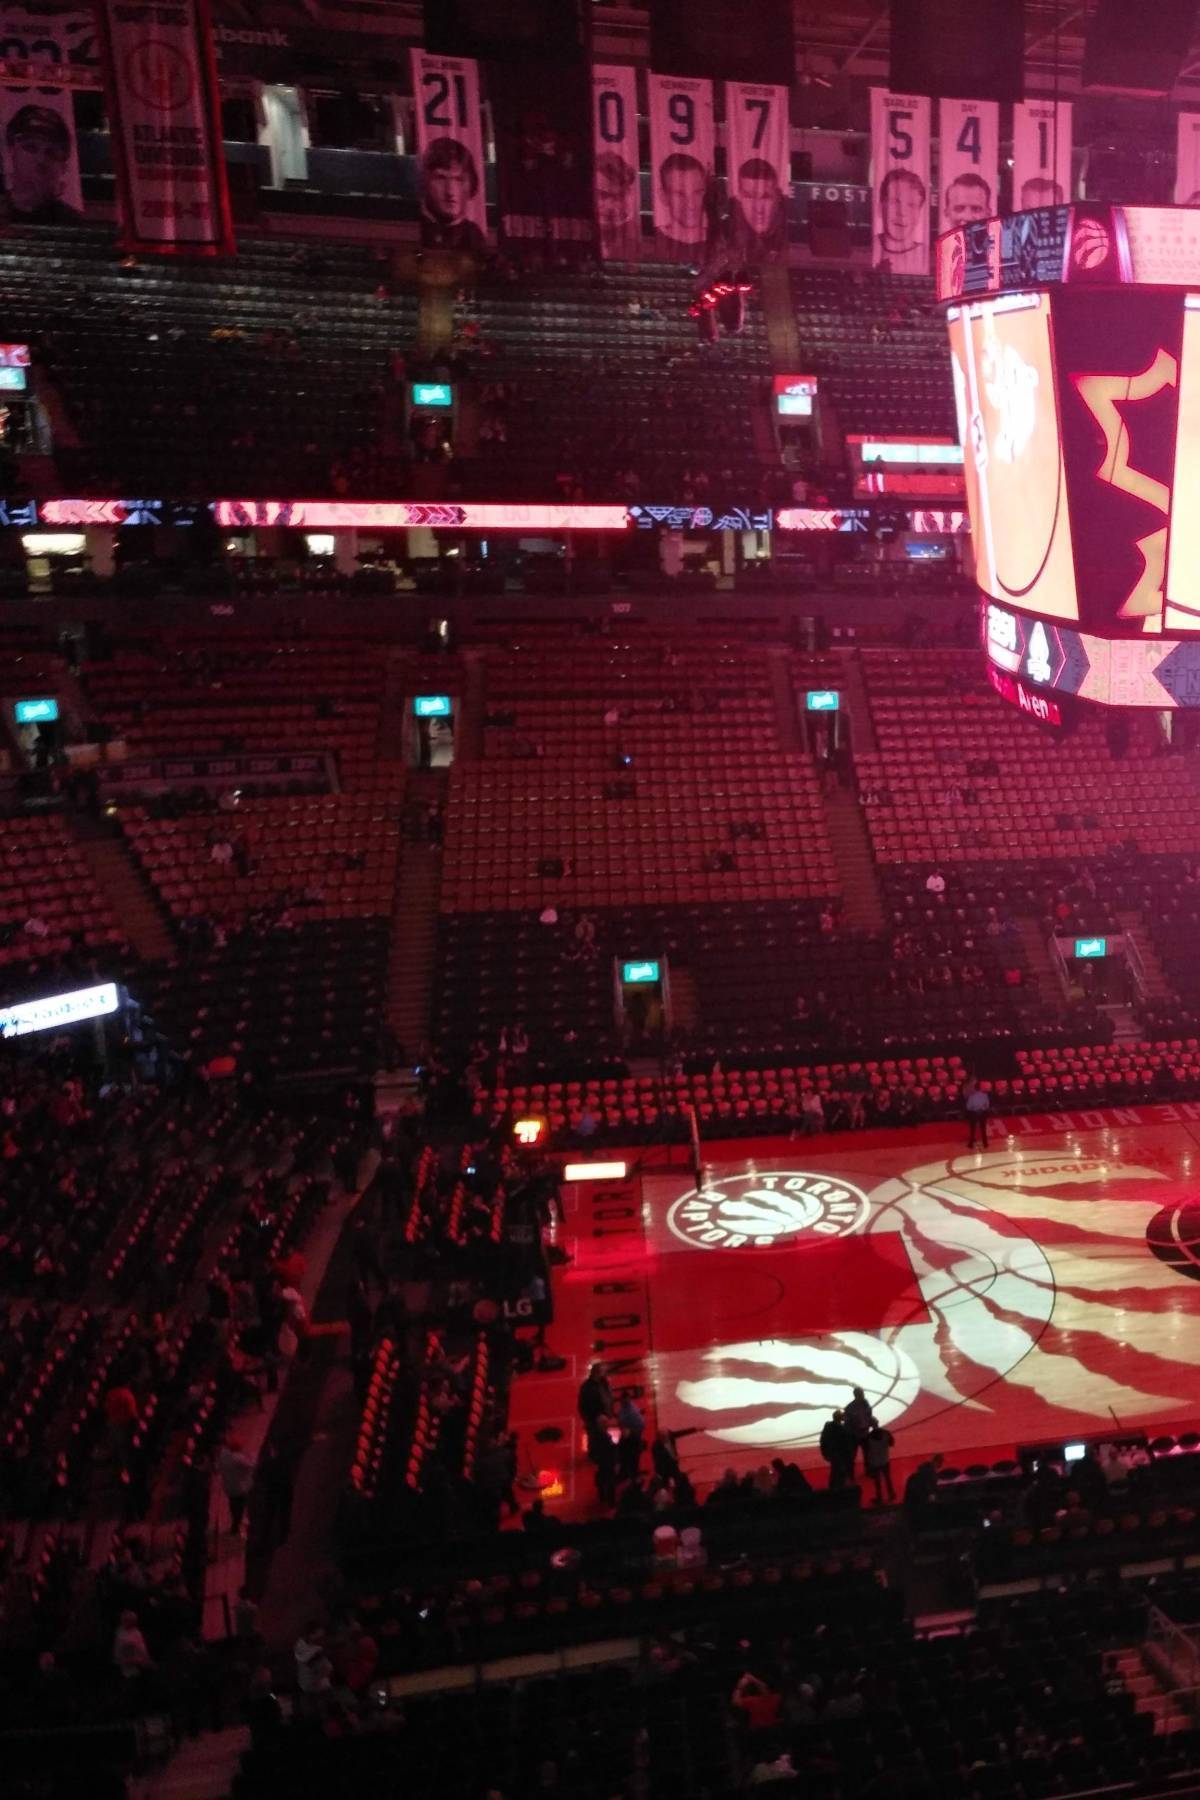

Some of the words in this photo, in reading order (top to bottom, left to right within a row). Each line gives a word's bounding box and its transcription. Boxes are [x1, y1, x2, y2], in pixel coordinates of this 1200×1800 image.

[422, 72, 468, 128] 21
[600, 90, 625, 144] 0
[668, 94, 695, 146] 9
[745, 99, 771, 150] 7
[888, 111, 914, 161] 5
[956, 116, 982, 165] 4
[1037, 121, 1048, 170] 1
[984, 1104, 1141, 1137] NORTH
[761, 1177, 858, 1234] TORONTO
[503, 1298, 534, 1318] LG
